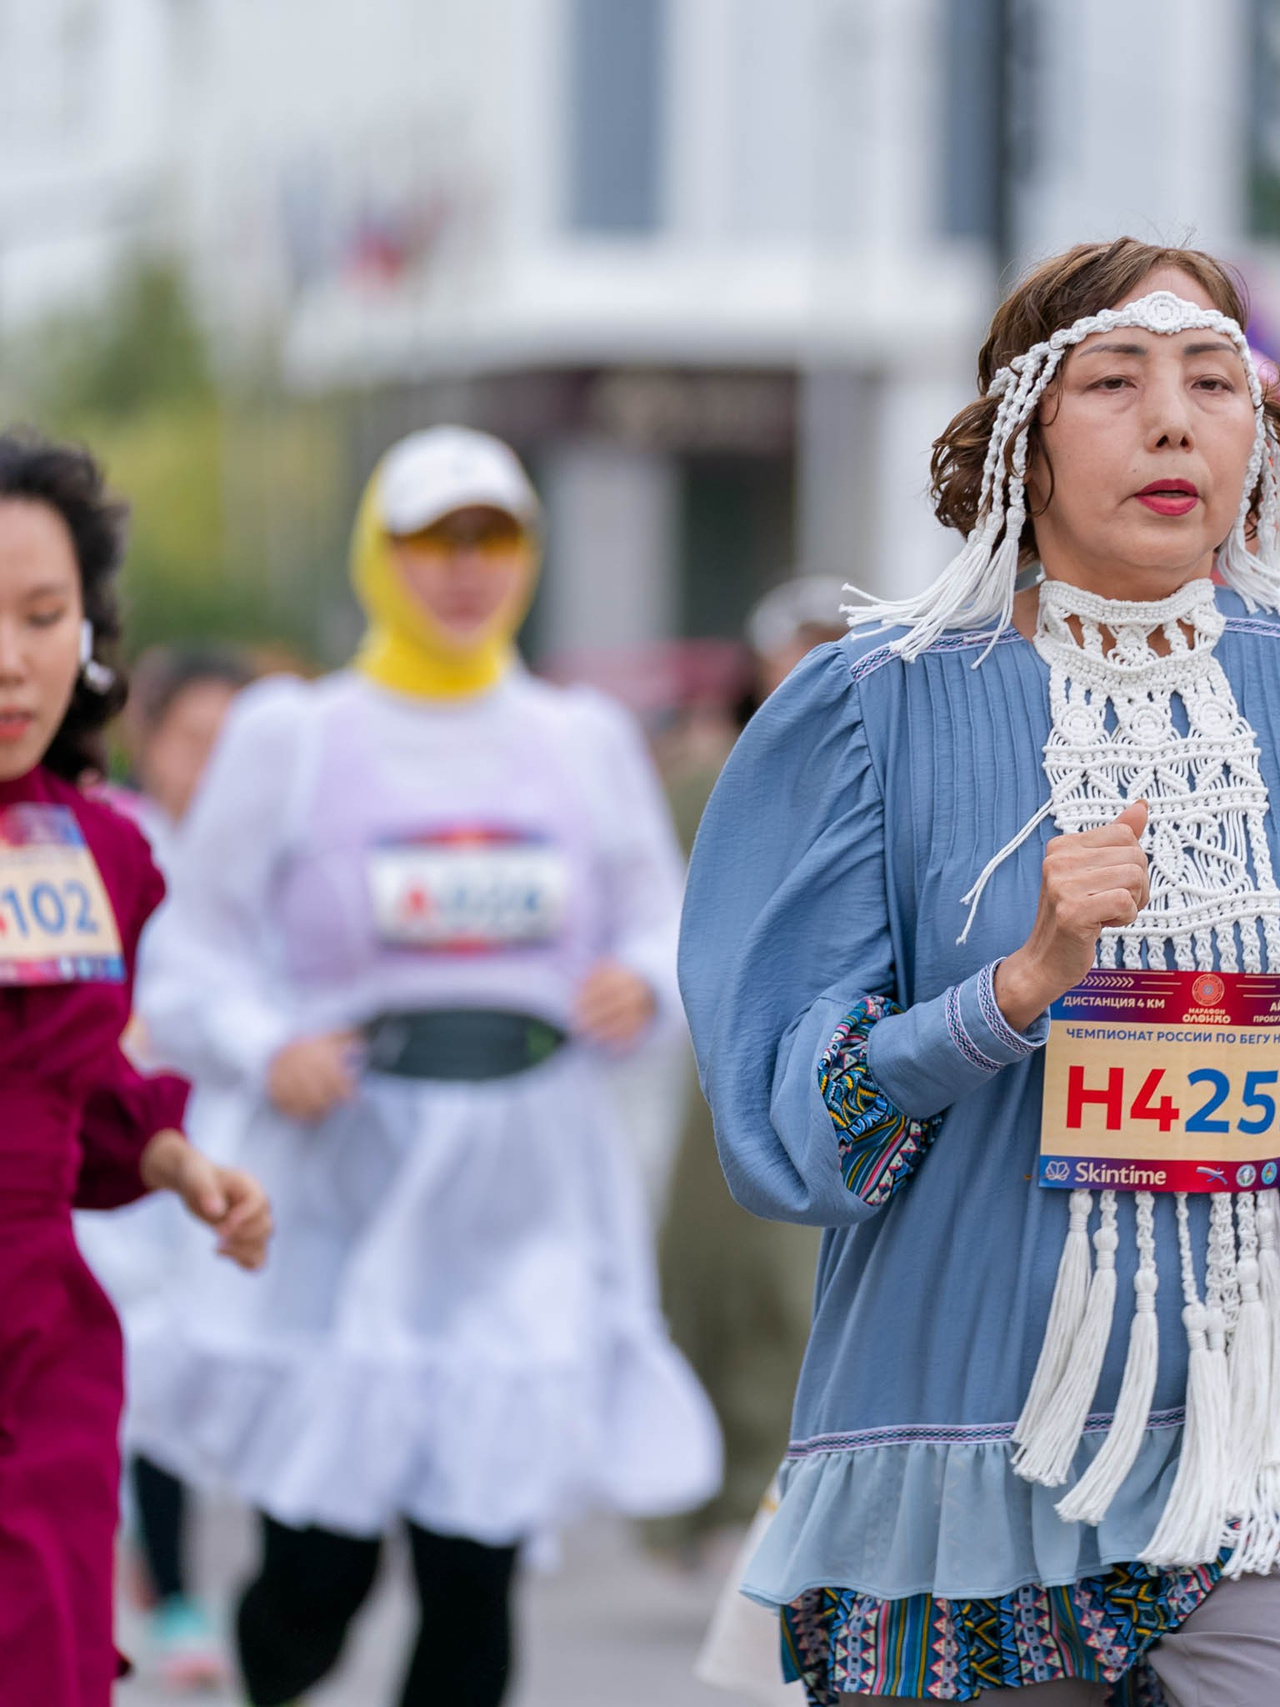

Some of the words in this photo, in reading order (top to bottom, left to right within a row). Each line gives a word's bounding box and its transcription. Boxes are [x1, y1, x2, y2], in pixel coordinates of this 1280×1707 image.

[0, 879, 99, 938] 102
[1062, 996, 1135, 1009] ДИСТАНЦИЯ
[1137, 999, 1145, 1008] 4
[1146, 999, 1165, 1009] КМ
[1188, 1007, 1226, 1015] МАРАФОН
[1066, 1028, 1153, 1041] ЧЕМПИОНАТ
[1157, 1031, 1212, 1043] РОССИИ
[1216, 1033, 1236, 1044] ПО
[1240, 1033, 1270, 1045] БЕГУ
[1074, 1162, 1167, 1185] Skintime
